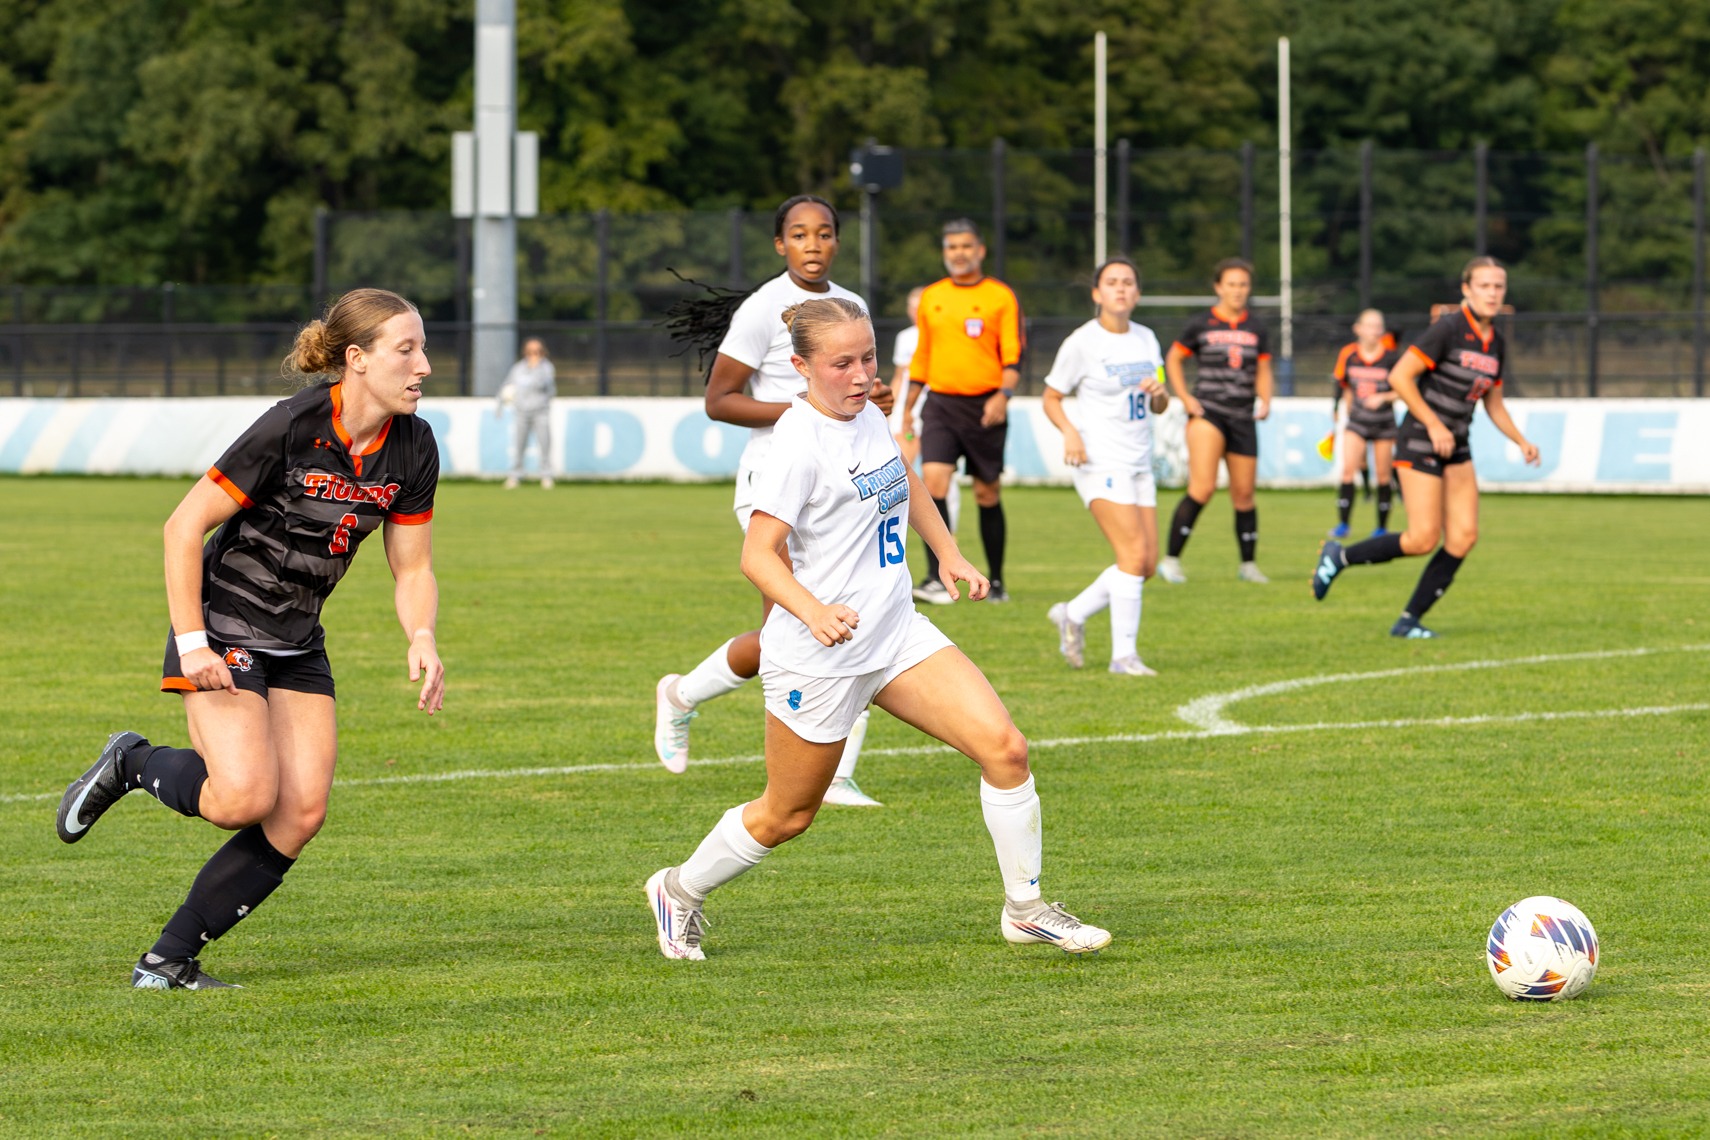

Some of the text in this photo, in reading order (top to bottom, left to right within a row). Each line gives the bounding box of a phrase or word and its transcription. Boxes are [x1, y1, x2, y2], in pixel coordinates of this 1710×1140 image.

[1129, 392, 1146, 421] 18
[1256, 411, 1680, 481] BUE
[878, 516, 905, 568] 15
